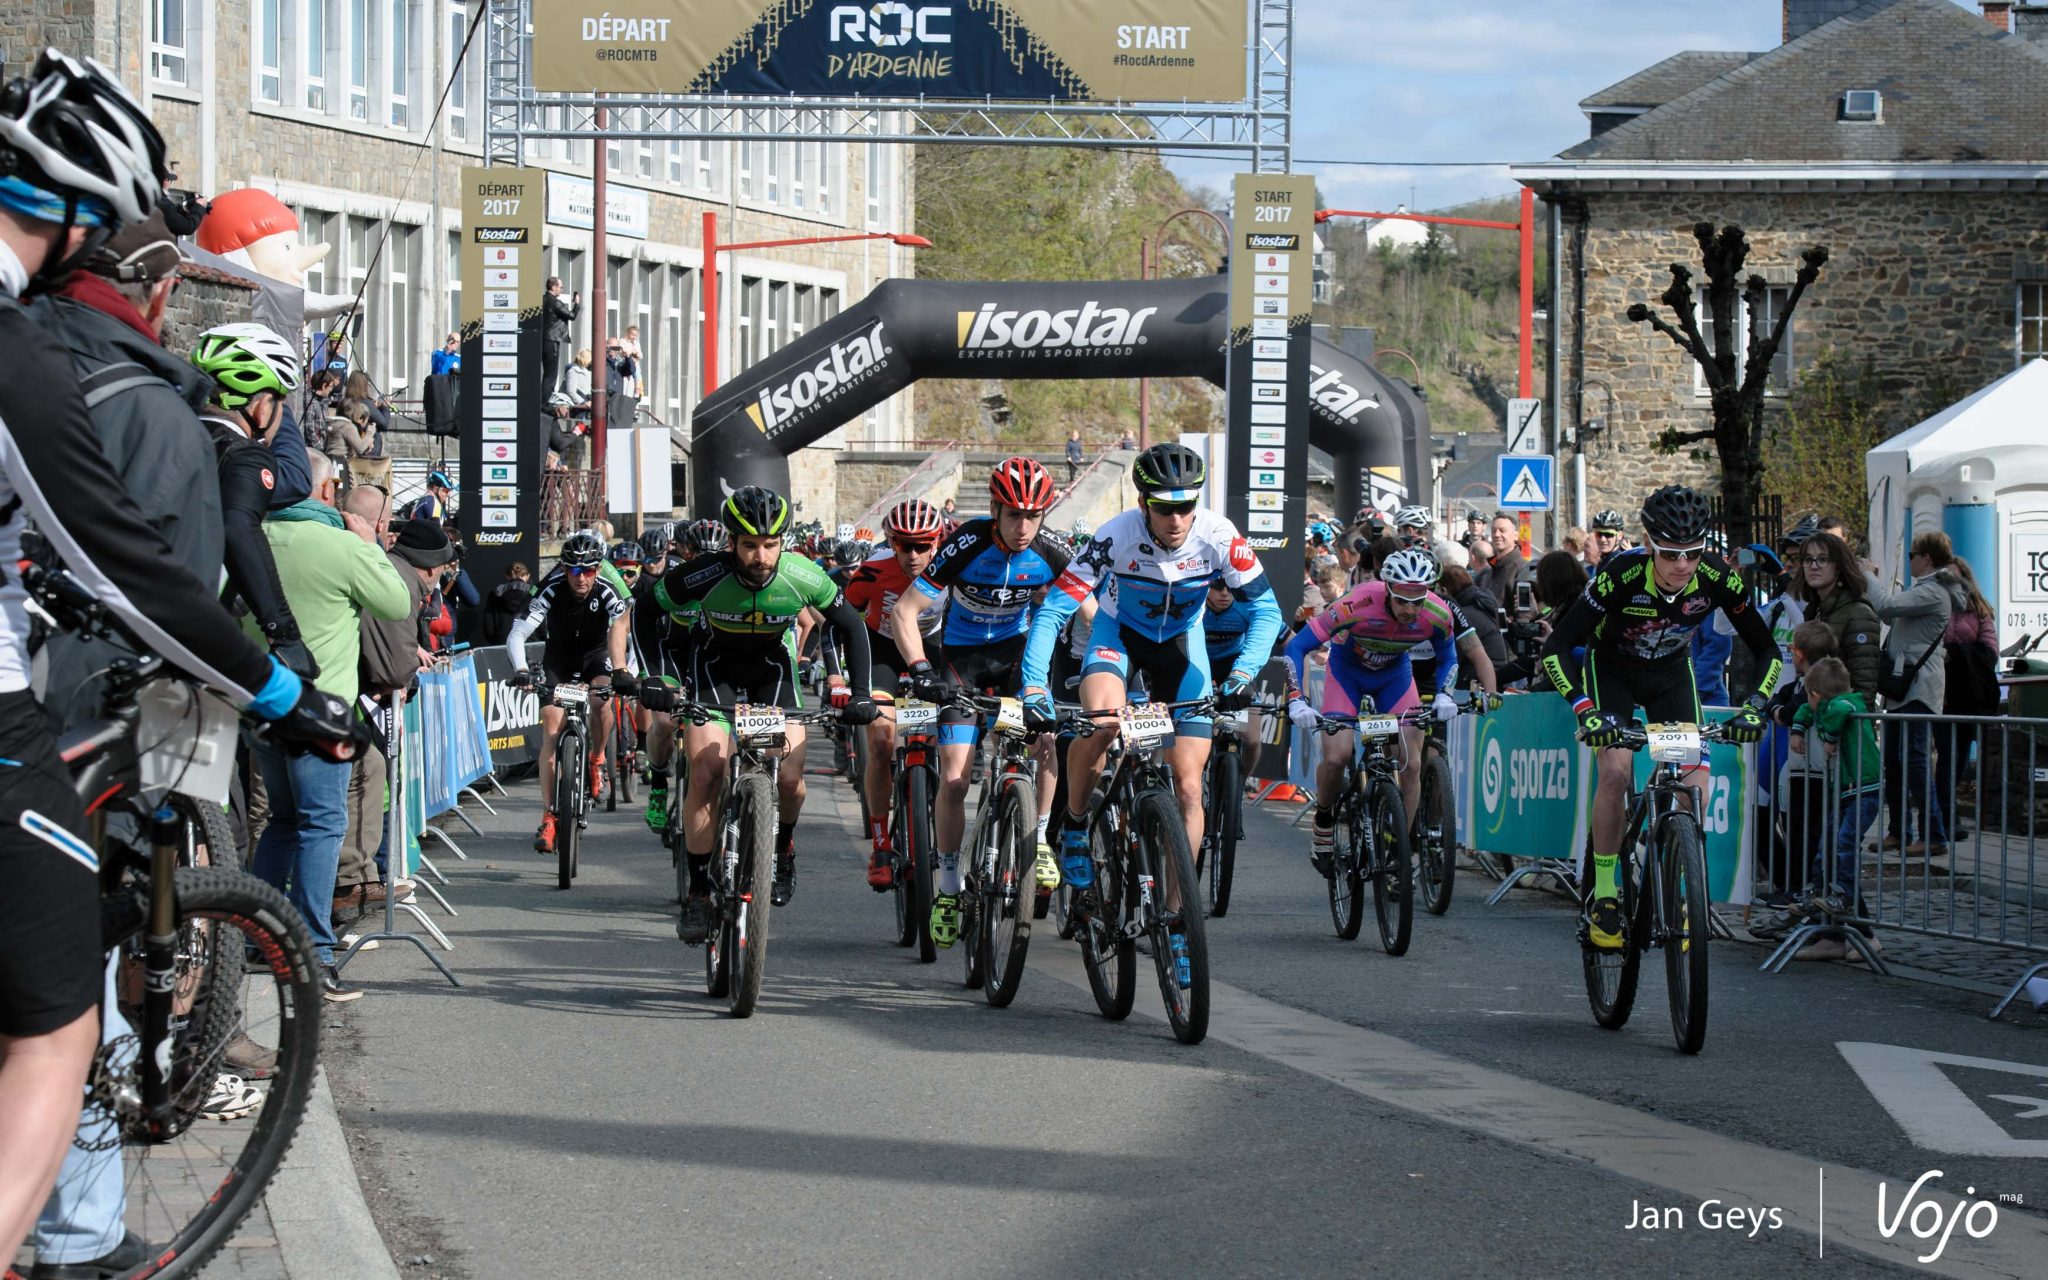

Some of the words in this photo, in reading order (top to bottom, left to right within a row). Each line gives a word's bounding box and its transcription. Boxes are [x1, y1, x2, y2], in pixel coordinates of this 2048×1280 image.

[582, 13, 671, 42] DÉPART
[830, 1, 951, 47] ROC
[1117, 25, 1191, 50] START
[596, 49, 658, 62] @ROCMTB
[1113, 55, 1195, 68] #RocdArdenne
[828, 50, 953, 79] D'ARDENNE
[478, 182, 525, 196] DÉPART
[1254, 190, 1293, 203] START
[483, 199, 520, 216] 2017
[1255, 206, 1292, 223] 2017
[480, 228, 521, 241] isostar
[1252, 234, 1293, 247] isostar
[966, 301, 1158, 348] isostar
[958, 349, 1013, 359] EXPERT
[1021, 349, 1036, 358] IN
[1045, 347, 1133, 358] SPORTFOOD
[759, 322, 885, 430] isostar
[765, 413, 805, 441] EXPERT
[808, 402, 822, 414] IN
[825, 360, 888, 404] SPORTFOOD
[1360, 467, 1370, 506] EXPER
[479, 531, 519, 543] isostar
[711, 611, 743, 622] BIKE
[745, 611, 764, 626] 4
[2008, 613, 2026, 627] 078
[1545, 660, 1568, 692] MAVIC
[1764, 661, 1783, 696] MAVIC
[903, 709, 929, 719] 3220
[742, 717, 780, 728] 10002
[1127, 720, 1167, 731] 10004
[1367, 721, 1391, 730] 2619
[1657, 733, 1688, 741] 2091
[1510, 748, 1569, 816] sporza
